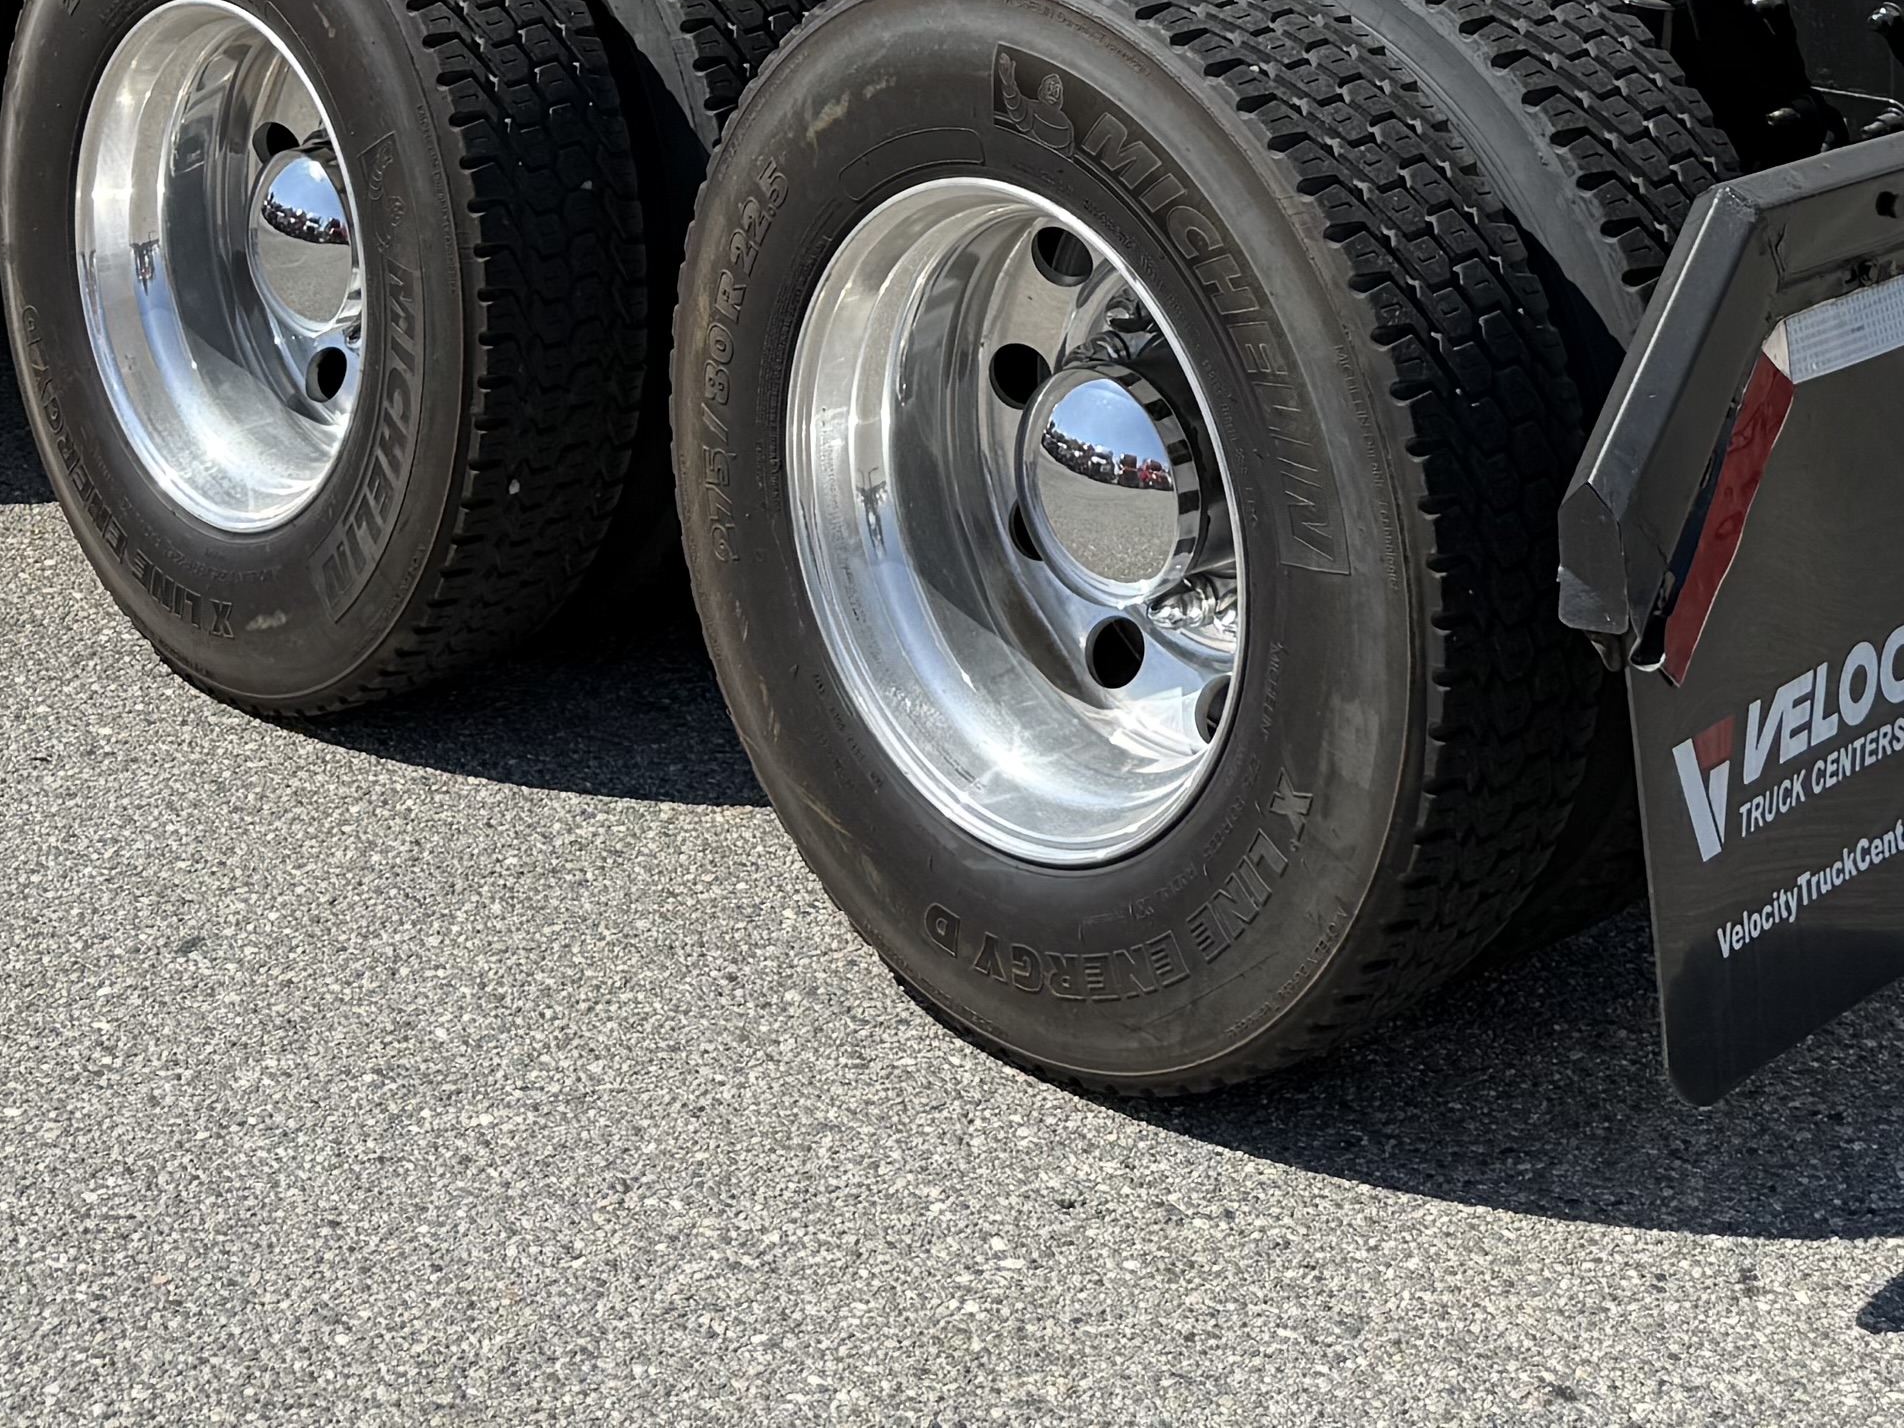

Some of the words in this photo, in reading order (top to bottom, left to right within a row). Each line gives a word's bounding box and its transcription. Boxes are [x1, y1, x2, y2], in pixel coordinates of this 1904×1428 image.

[1739, 781, 1807, 838] TRUCK
[1185, 827, 1290, 965] LINE
[972, 928, 1192, 1003] ENERGY
